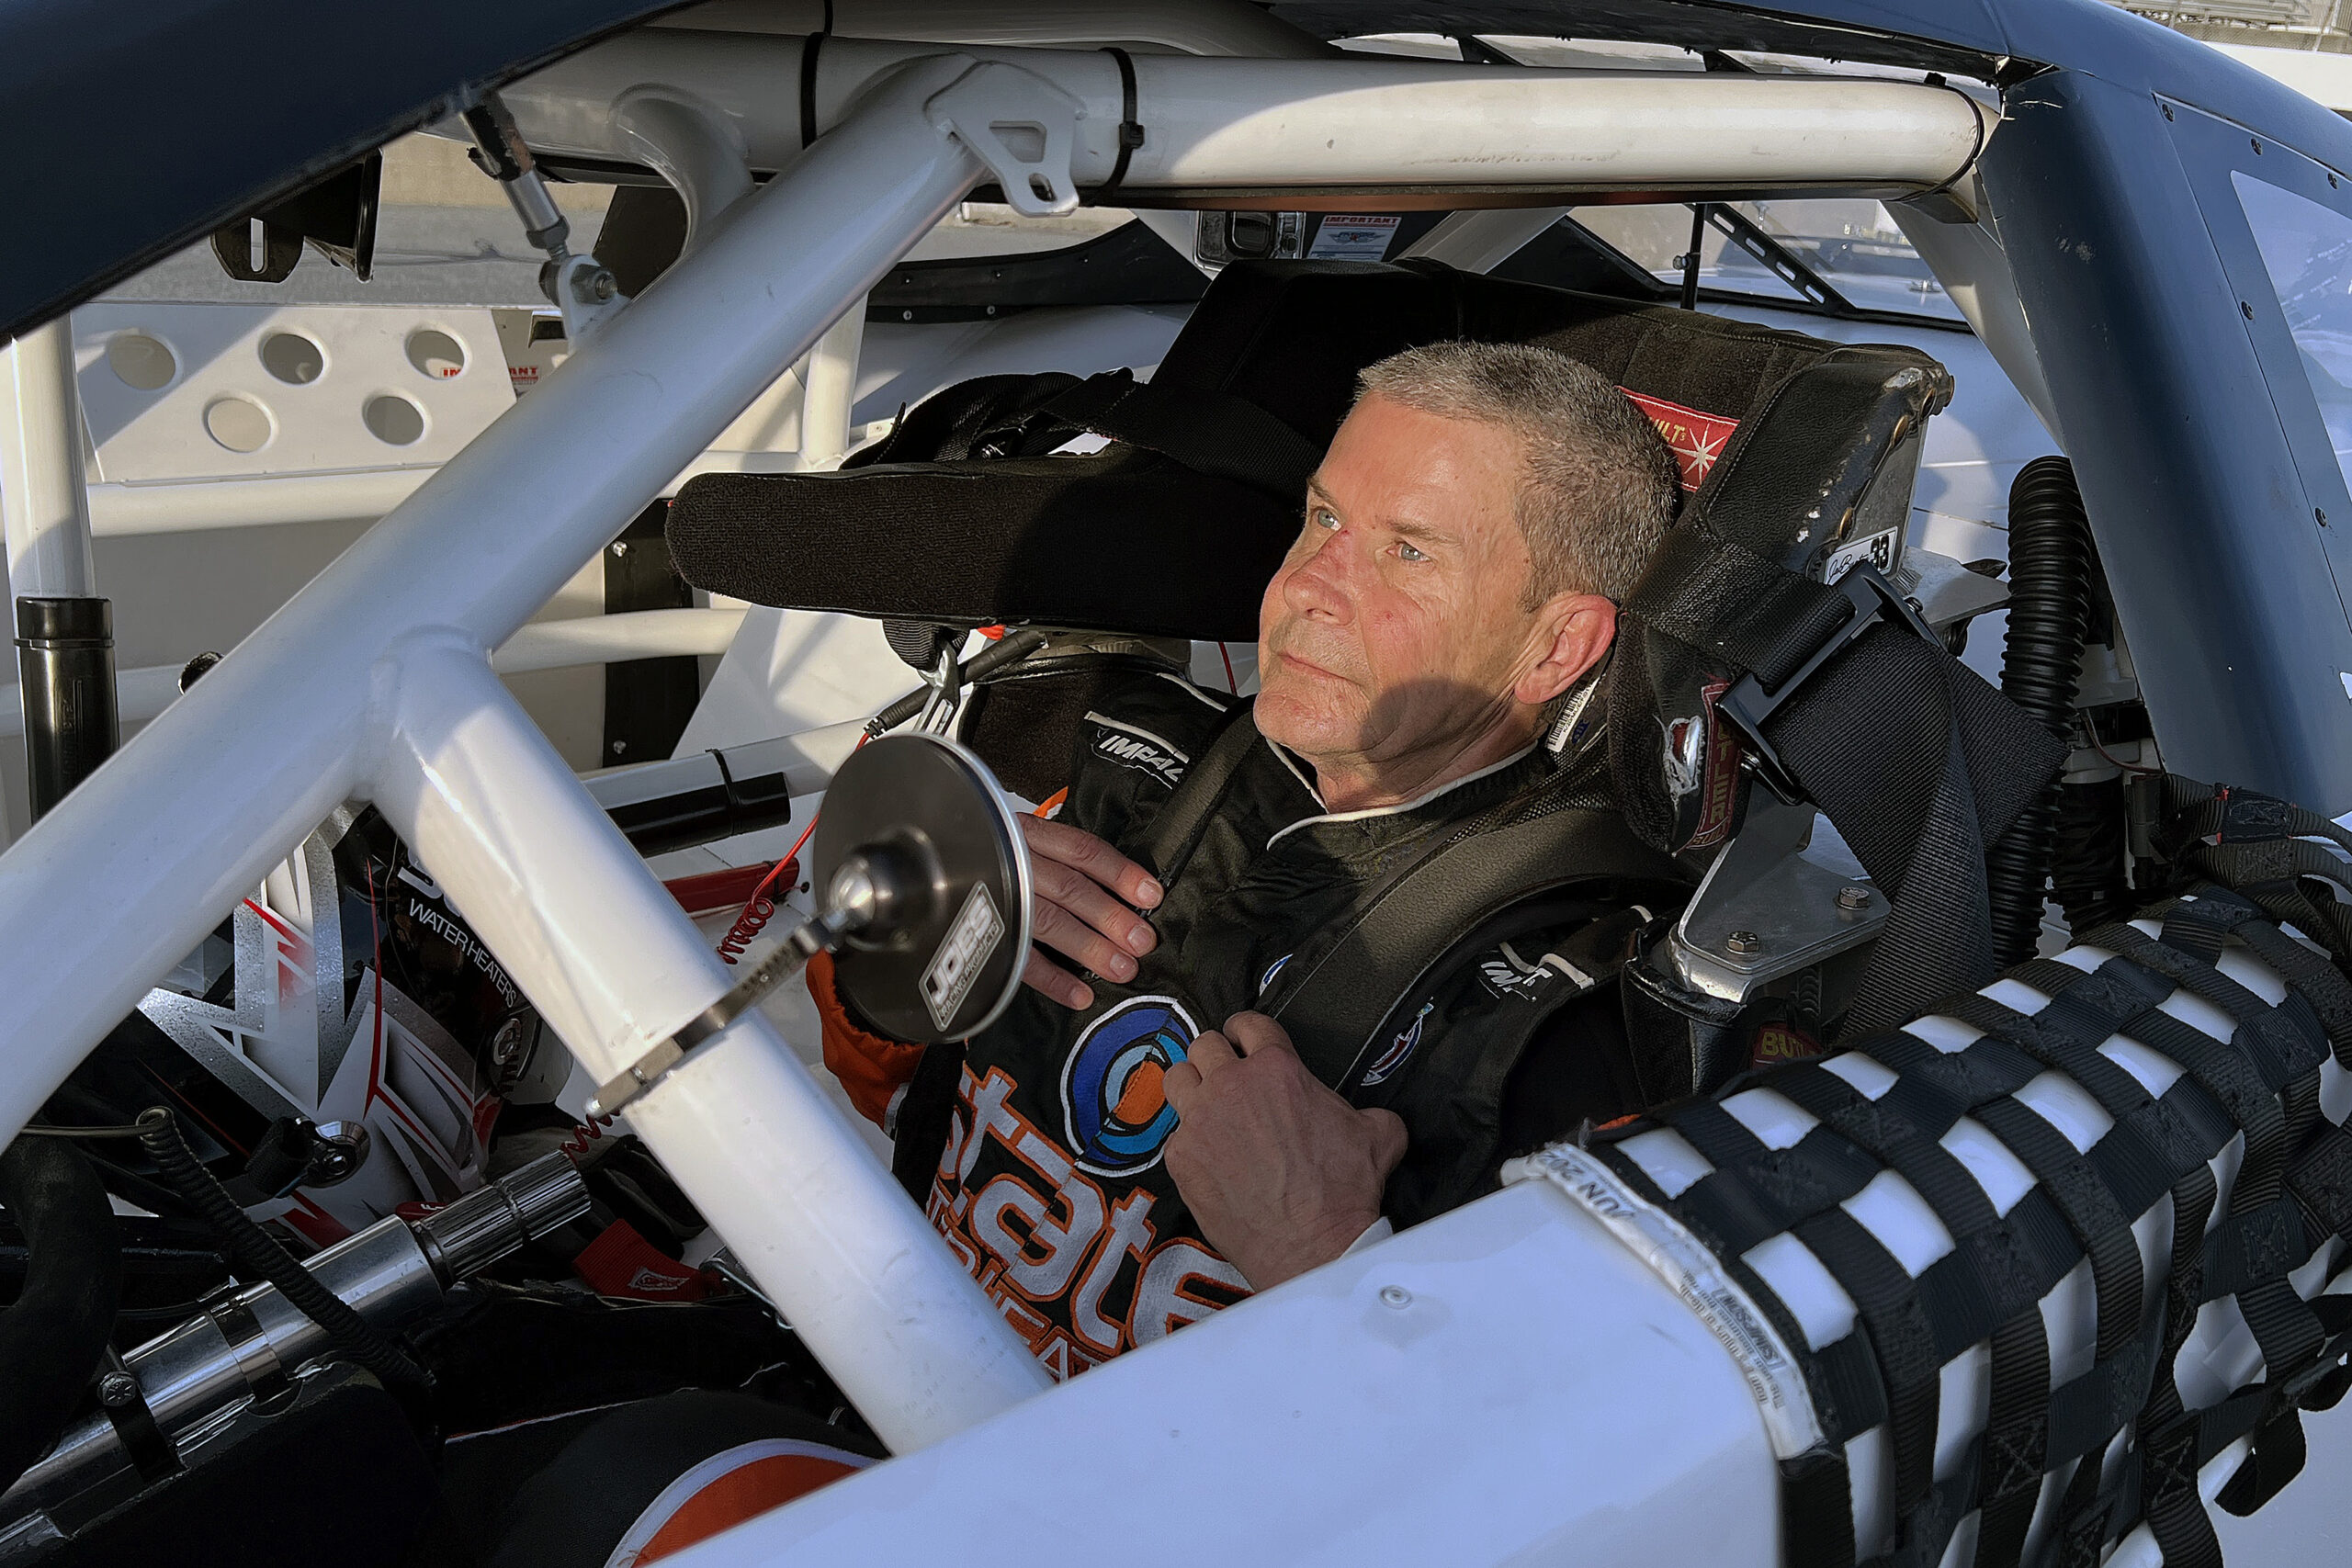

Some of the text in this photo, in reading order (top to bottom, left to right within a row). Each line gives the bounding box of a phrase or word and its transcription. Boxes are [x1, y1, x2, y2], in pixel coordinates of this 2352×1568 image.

[1325, 216, 1398, 224] IMPORTANT
[1099, 735, 1183, 783] IMPAC
[1709, 722, 1733, 824] UTLER
[409, 898, 516, 1008] WATER HEATERS
[931, 894, 993, 1006] JOES
[940, 921, 999, 1019] RACING PRODUCTS
[1577, 1180, 1636, 1218] JUN
[1720, 1294, 1777, 1360] SIMPSON
